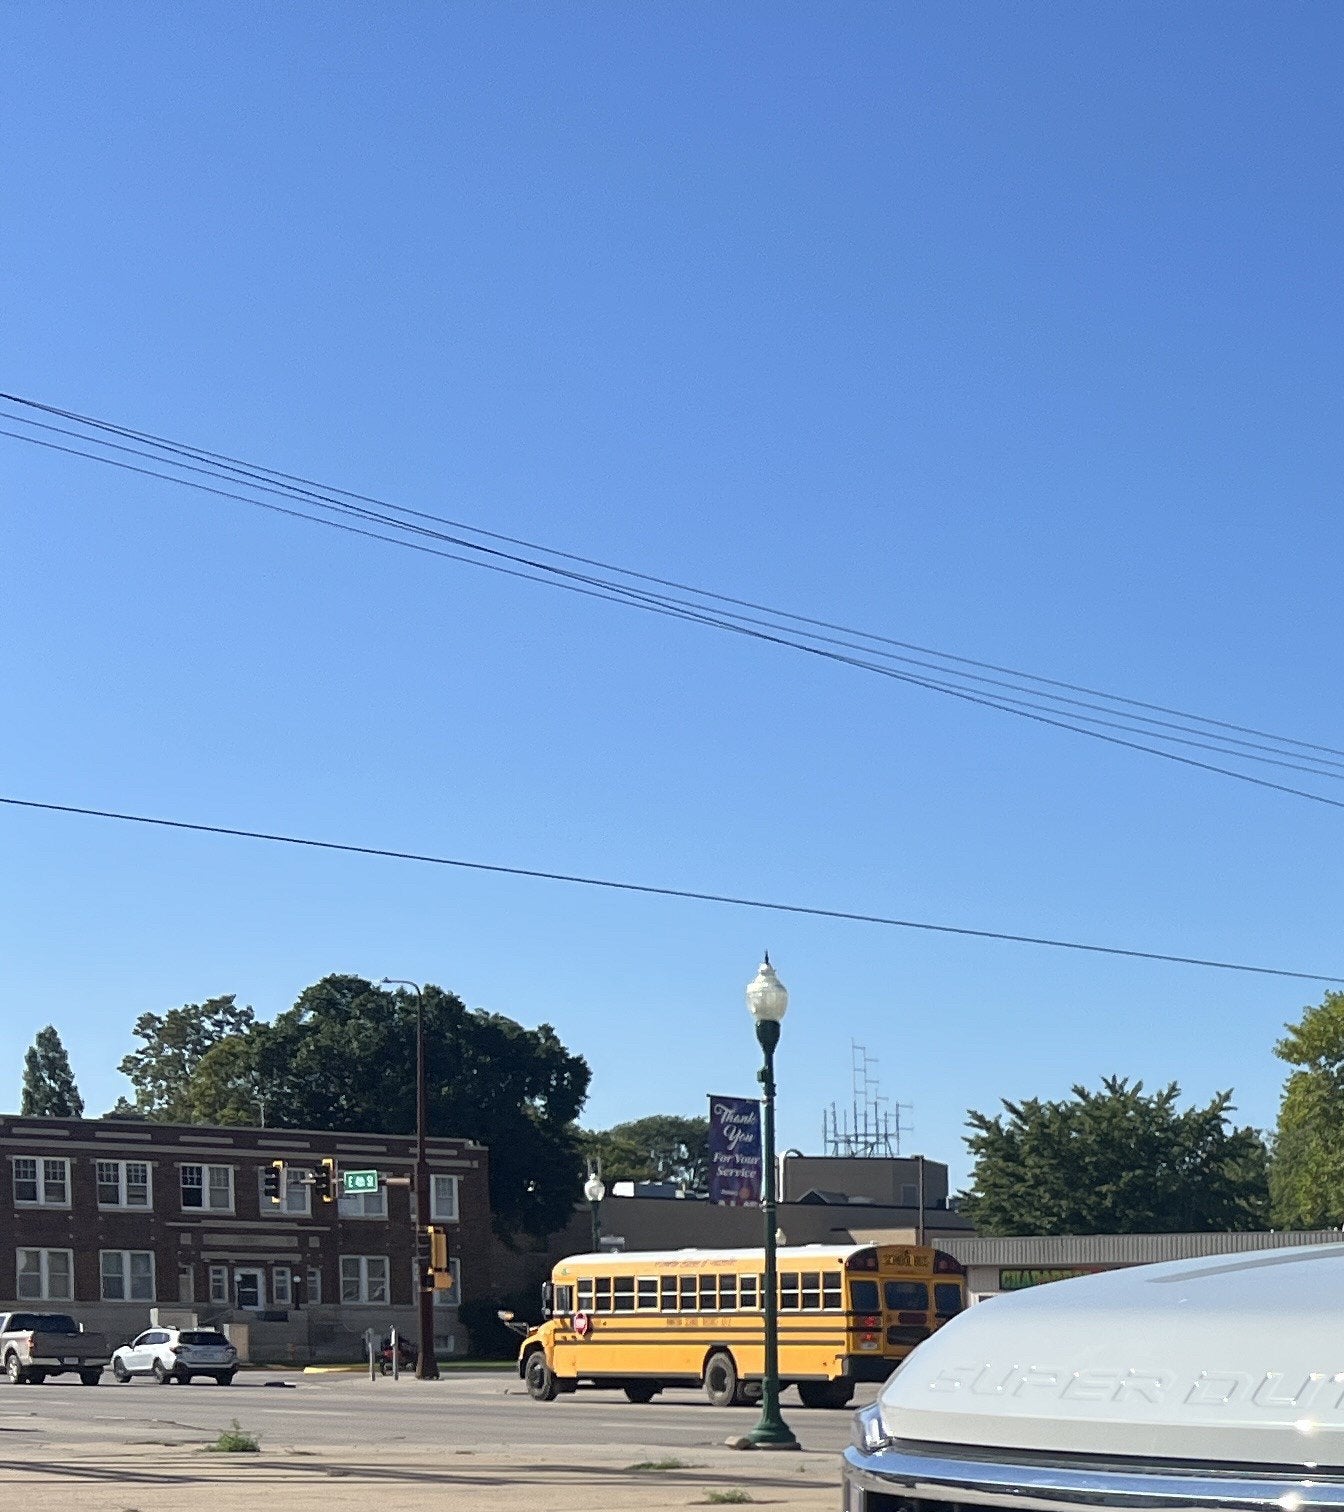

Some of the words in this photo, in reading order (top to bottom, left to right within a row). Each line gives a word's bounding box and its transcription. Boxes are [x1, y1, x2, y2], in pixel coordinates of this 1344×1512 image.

[714, 1103, 756, 1124] Thank
[723, 1124, 754, 1151] You
[716, 1166, 757, 1178] Service
[931, 1362, 1174, 1404] SUPER
